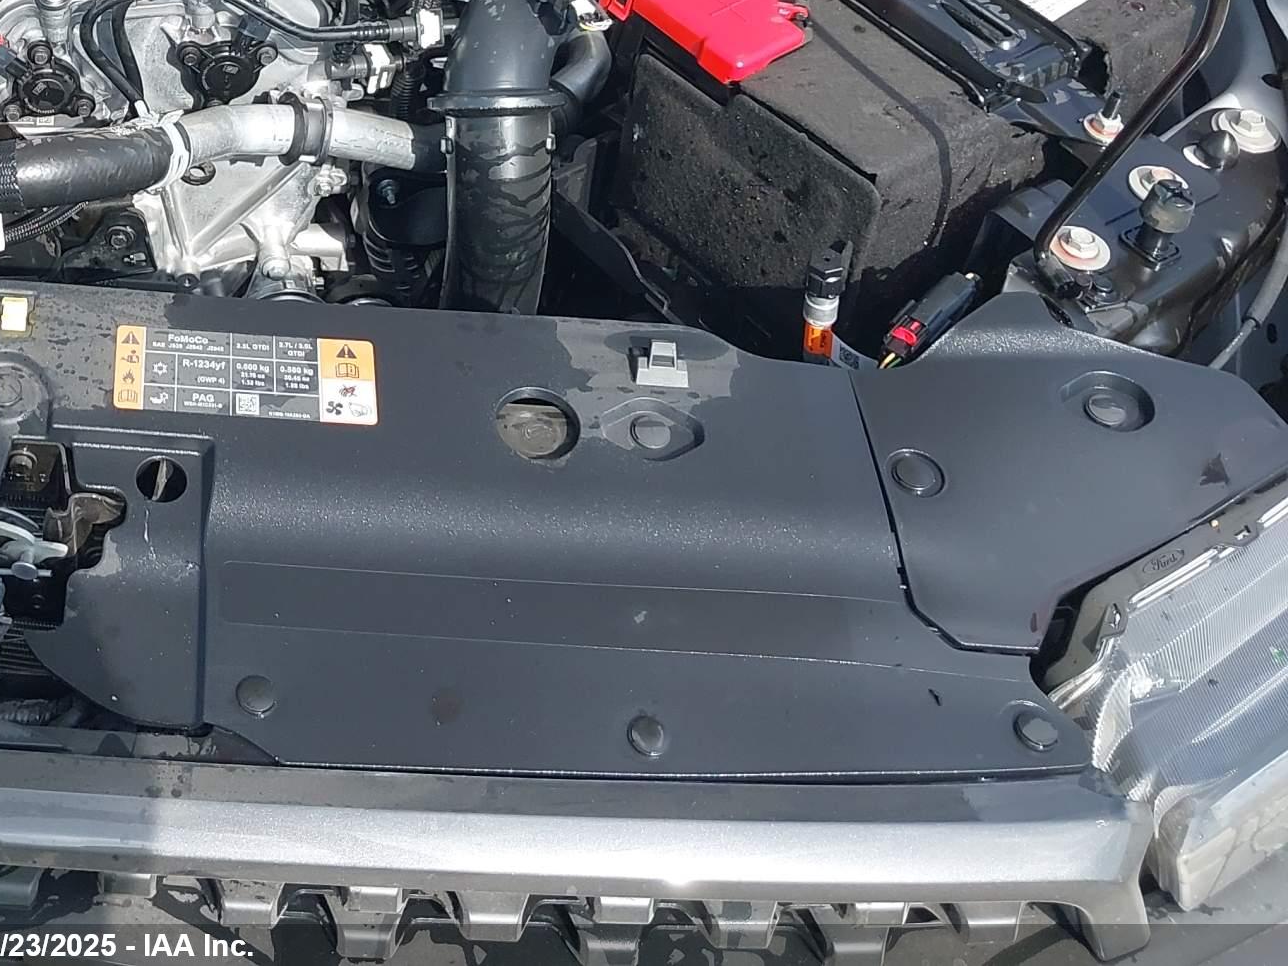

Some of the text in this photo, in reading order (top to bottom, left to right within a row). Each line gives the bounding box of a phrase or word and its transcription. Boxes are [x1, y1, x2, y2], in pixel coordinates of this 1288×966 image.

[168, 334, 209, 344] FoMoCo
[182, 359, 226, 371] R-1234yf
[259, 364, 270, 373] kg
[303, 367, 314, 376] kg
[218, 377, 226, 385] 4)
[192, 393, 215, 402] PAG
[1150, 553, 1179, 571] Ford
